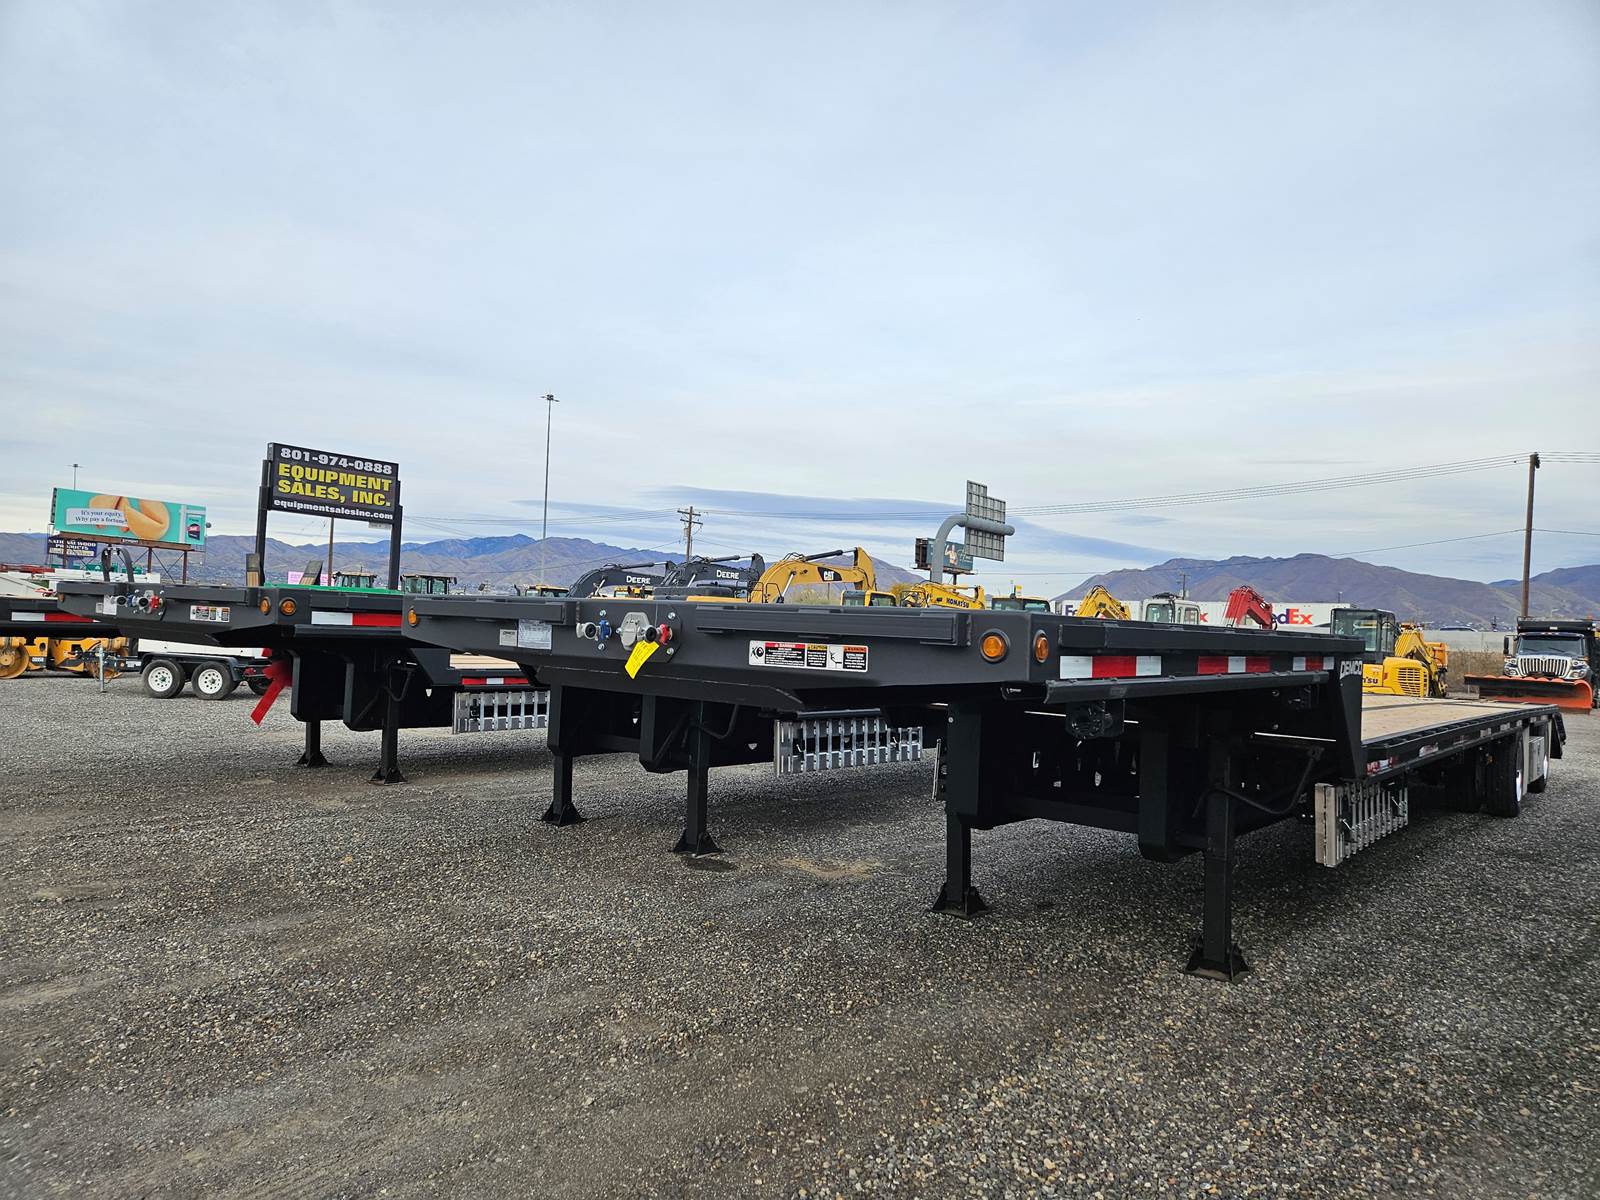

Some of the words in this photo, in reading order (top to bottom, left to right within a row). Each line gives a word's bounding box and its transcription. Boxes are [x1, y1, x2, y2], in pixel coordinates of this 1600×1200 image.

[280, 447, 393, 475] 801-974-0888
[278, 462, 392, 492] EQUIPMENT
[278, 479, 346, 504] SALES,
[352, 489, 391, 507] INC.
[273, 499, 393, 520] equipmentsalesinc.com
[626, 575, 651, 585] DEERE
[716, 569, 740, 580] DEERE
[823, 571, 834, 581] CAT
[946, 597, 969, 608] KOMATSU
